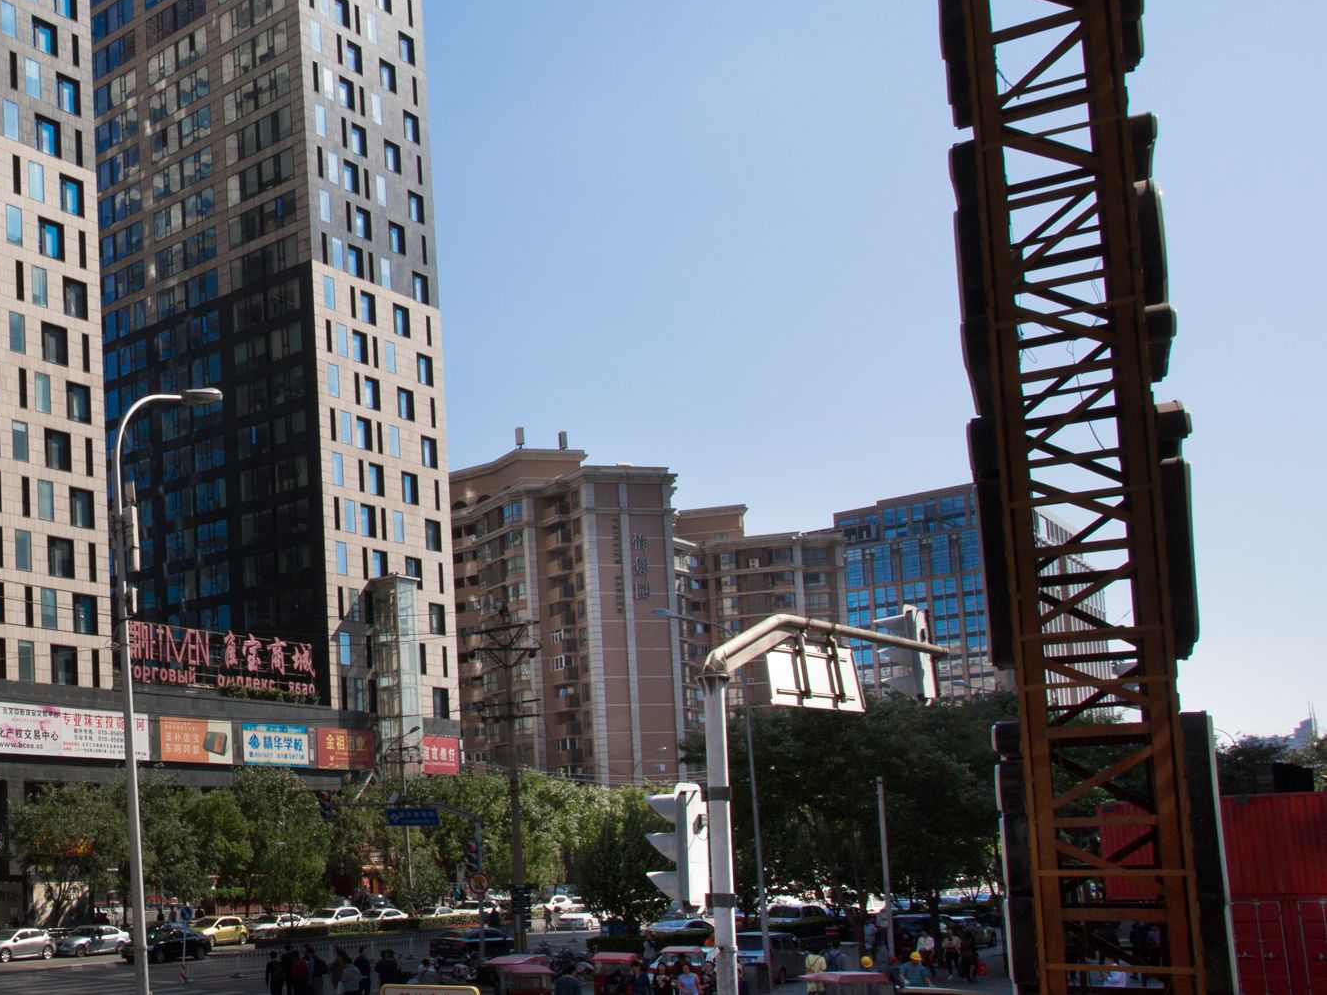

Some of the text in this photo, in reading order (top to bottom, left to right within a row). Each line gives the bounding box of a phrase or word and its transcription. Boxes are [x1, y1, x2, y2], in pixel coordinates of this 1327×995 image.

[62, 712, 145, 732] 专业珠宝投资问
[262, 735, 304, 752] 精华学校
